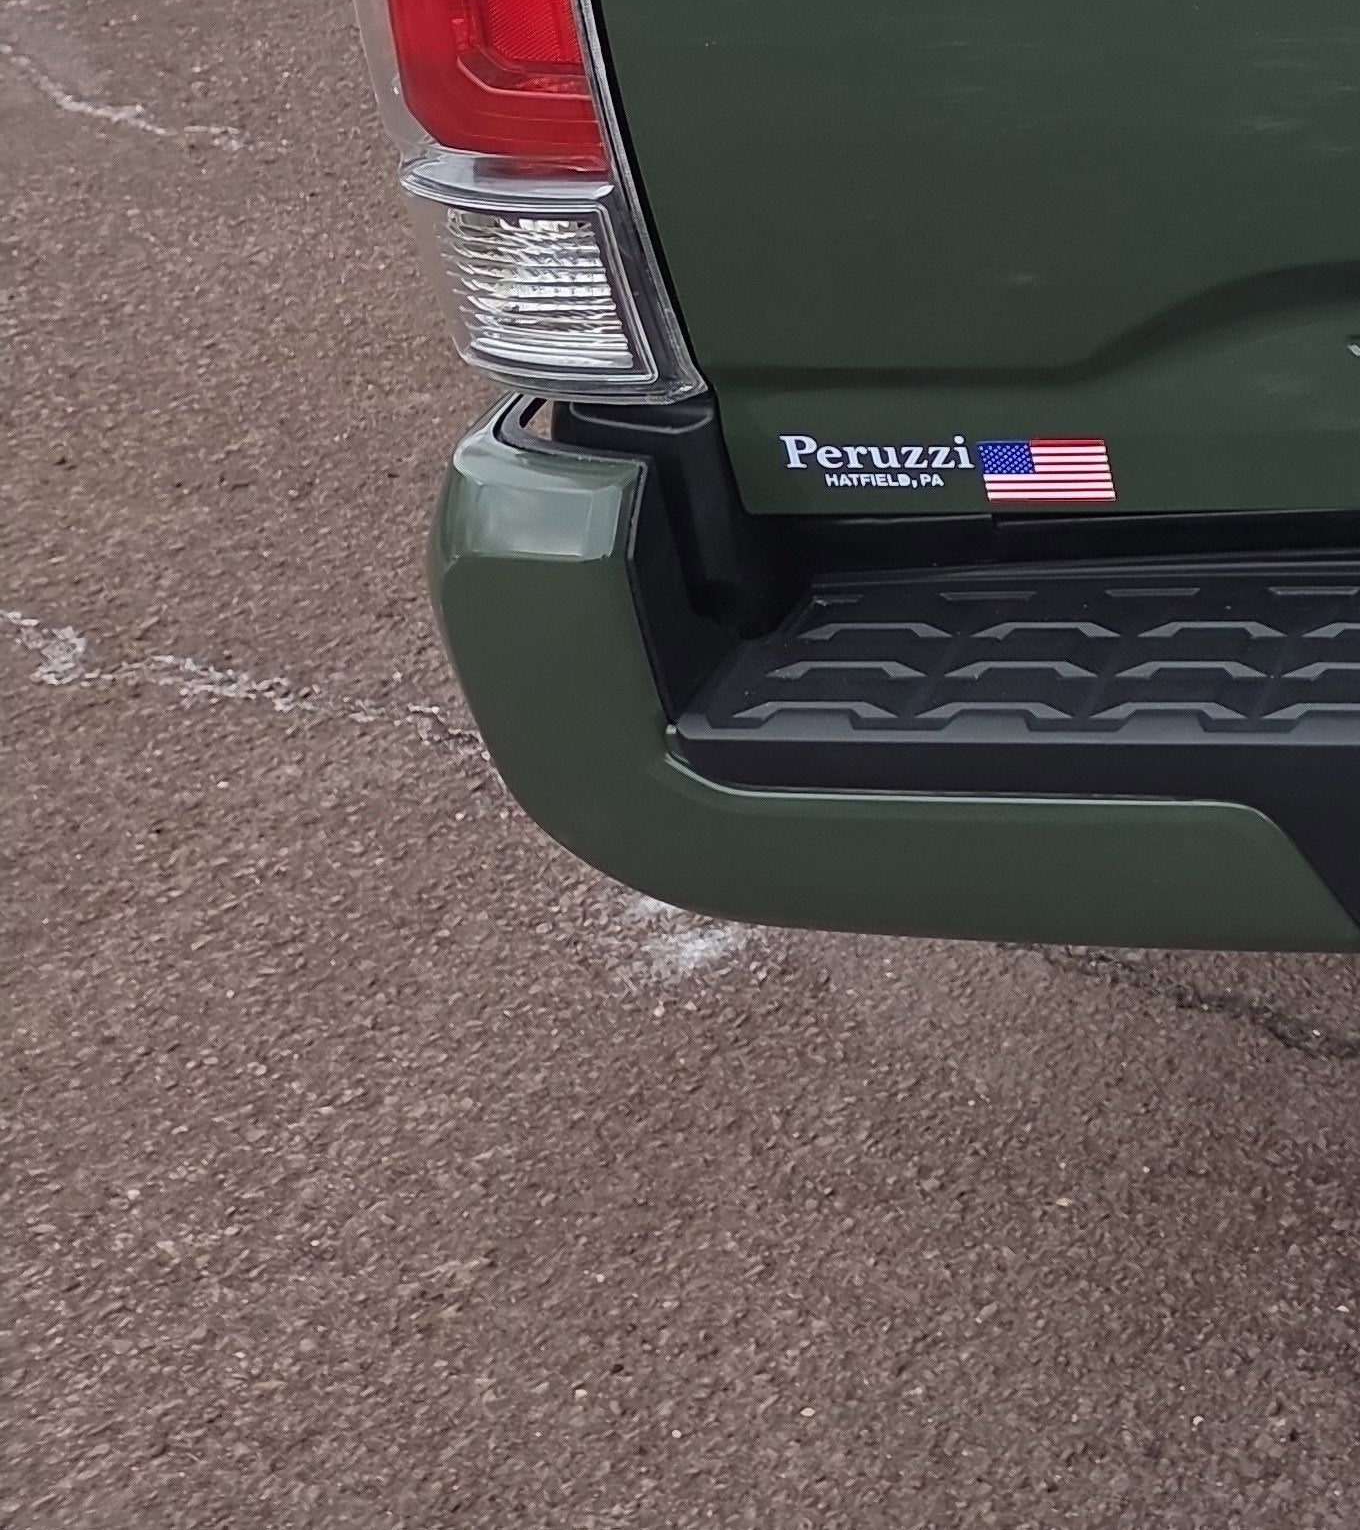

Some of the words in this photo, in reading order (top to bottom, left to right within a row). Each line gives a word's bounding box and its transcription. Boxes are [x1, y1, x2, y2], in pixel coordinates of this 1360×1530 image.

[779, 435, 976, 469] Peruzzi
[824, 473, 918, 488] HATFIELD,
[919, 473, 945, 488] PA
